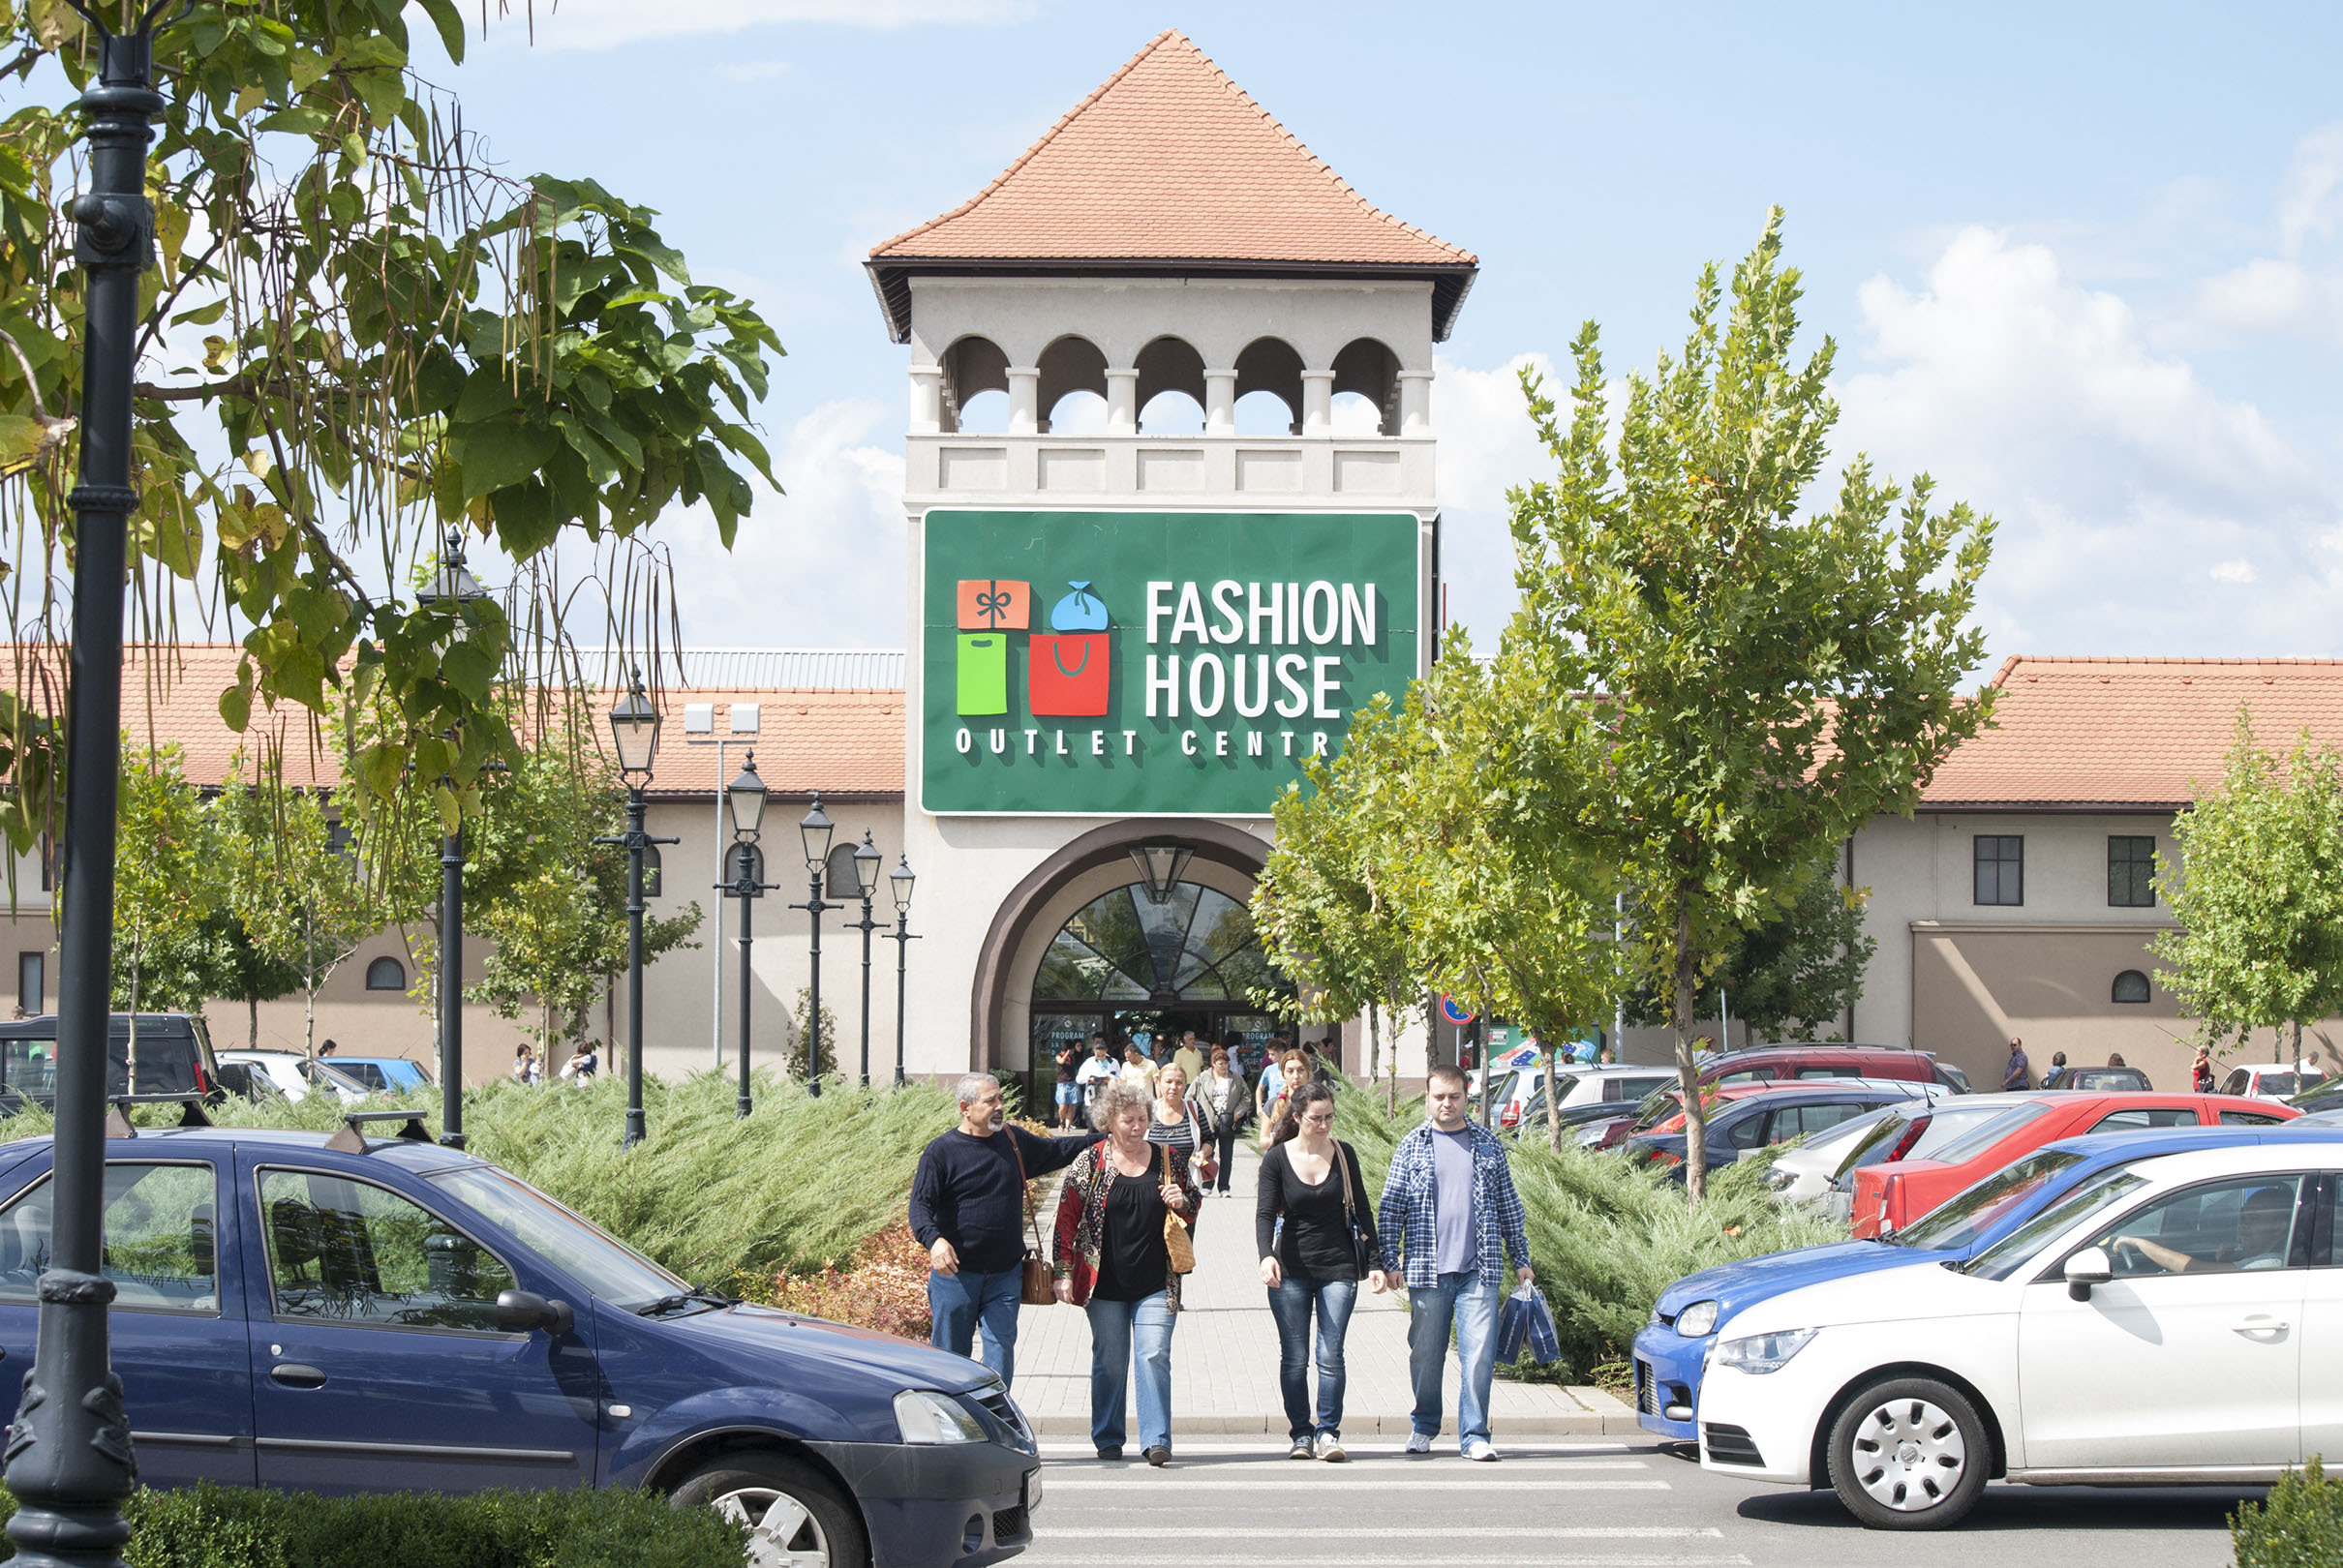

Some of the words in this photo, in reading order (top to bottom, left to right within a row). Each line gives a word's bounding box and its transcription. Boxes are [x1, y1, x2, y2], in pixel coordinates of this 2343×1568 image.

[1145, 579, 1376, 646] FASHION
[1145, 652, 1341, 719] HOUSE
[955, 727, 1137, 755] OUTLET
[1181, 729, 1354, 757] CENTR
[1051, 1031, 1084, 1040] PROGRAM
